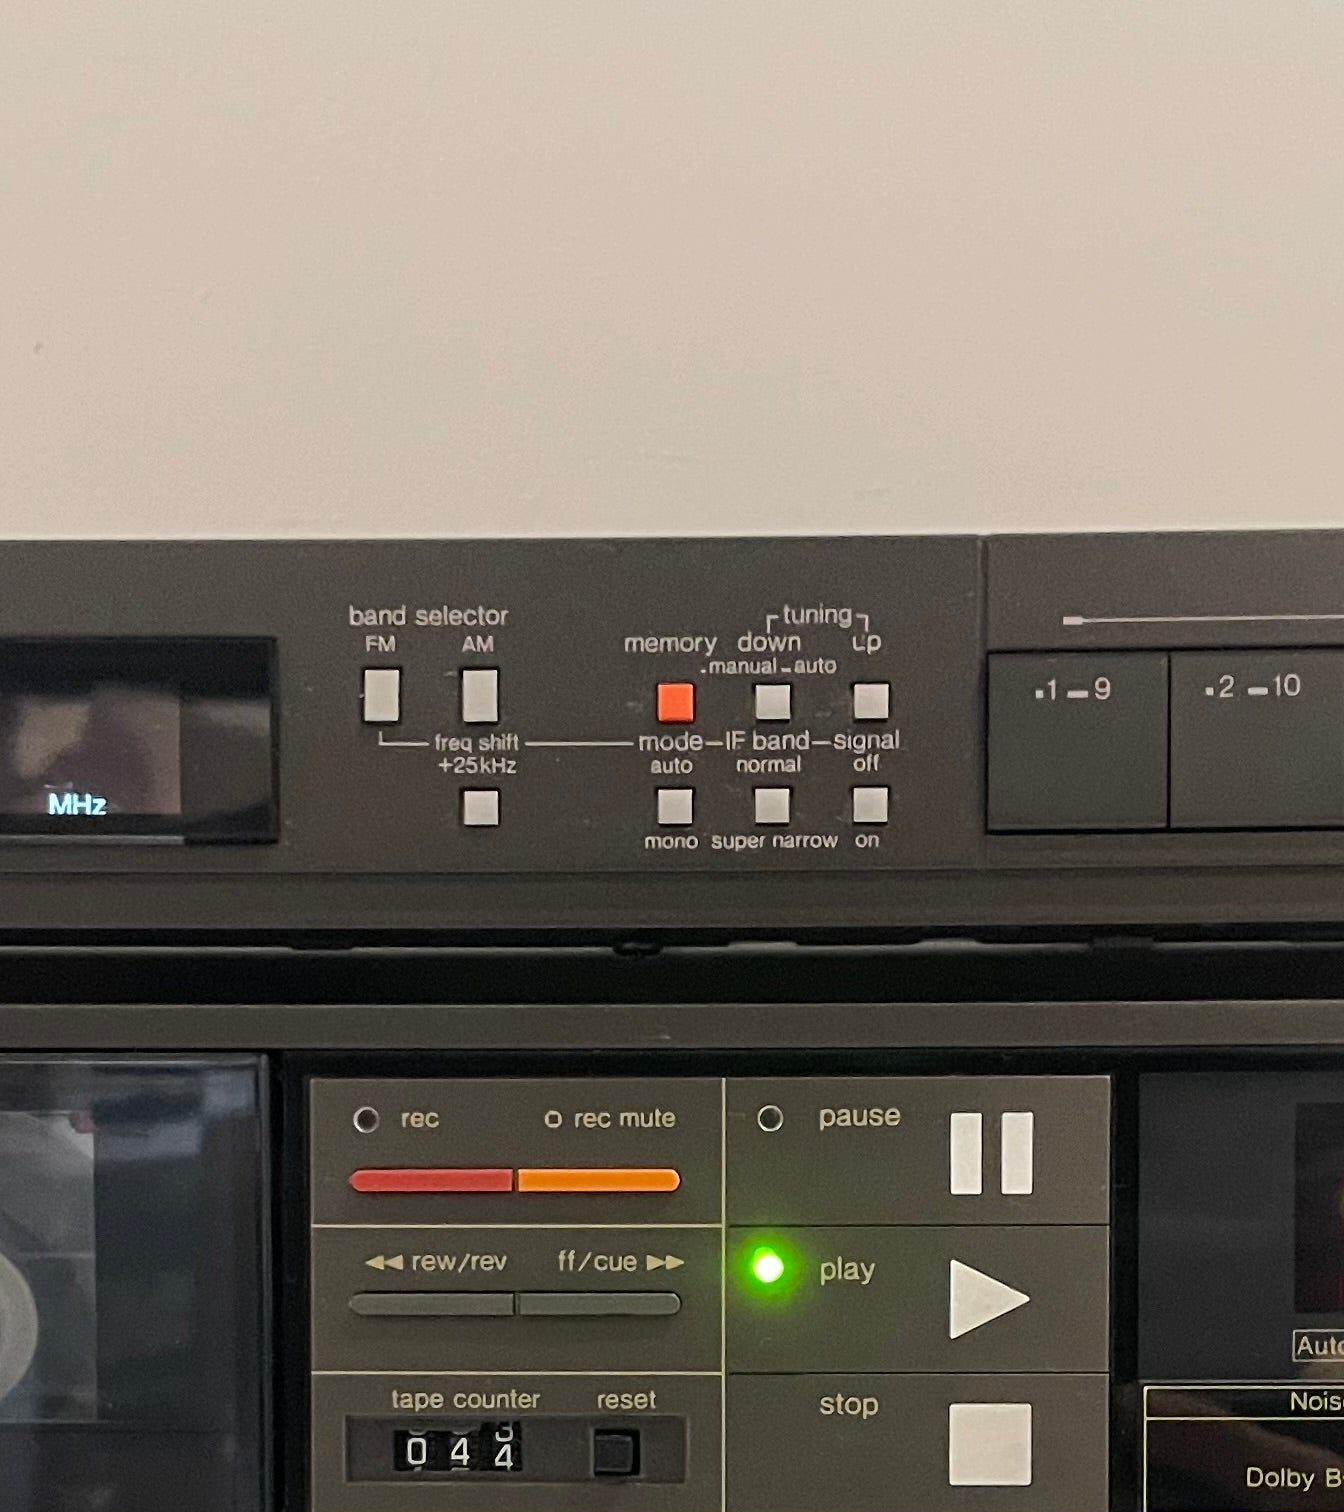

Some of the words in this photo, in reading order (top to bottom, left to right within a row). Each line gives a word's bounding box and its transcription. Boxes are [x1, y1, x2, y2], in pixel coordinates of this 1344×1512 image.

[348, 605, 406, 626] band
[414, 606, 508, 626] selector
[783, 604, 852, 628] tuning
[366, 635, 396, 652] FM
[462, 635, 494, 652] AM
[624, 636, 718, 656] memory
[737, 632, 801, 652] down
[852, 634, 882, 655] up
[708, 658, 778, 674] manual
[794, 658, 837, 674] auto
[434, 734, 473, 754] freq
[478, 733, 519, 752] shift
[638, 732, 703, 752] mode
[725, 730, 746, 750] IF
[752, 730, 810, 750] band
[834, 730, 900, 754] signal
[438, 756, 517, 774] +25kHz
[650, 758, 694, 774] auto
[736, 756, 802, 774] normal
[48, 792, 107, 816] MHz
[644, 835, 698, 850] mono
[711, 834, 765, 852] super
[772, 834, 838, 849] narrow
[401, 1110, 440, 1128] rec
[574, 1110, 612, 1128] rec
[620, 1108, 676, 1128] mute
[819, 1106, 900, 1131] pause
[412, 1252, 508, 1274] rew/rev
[558, 1250, 638, 1272] ff/cue
[820, 1256, 876, 1285] play
[392, 1390, 444, 1412] tape
[452, 1389, 540, 1409] counter
[597, 1390, 656, 1410] reset
[820, 1393, 878, 1419] stop
[1246, 1466, 1314, 1492] Dolby
